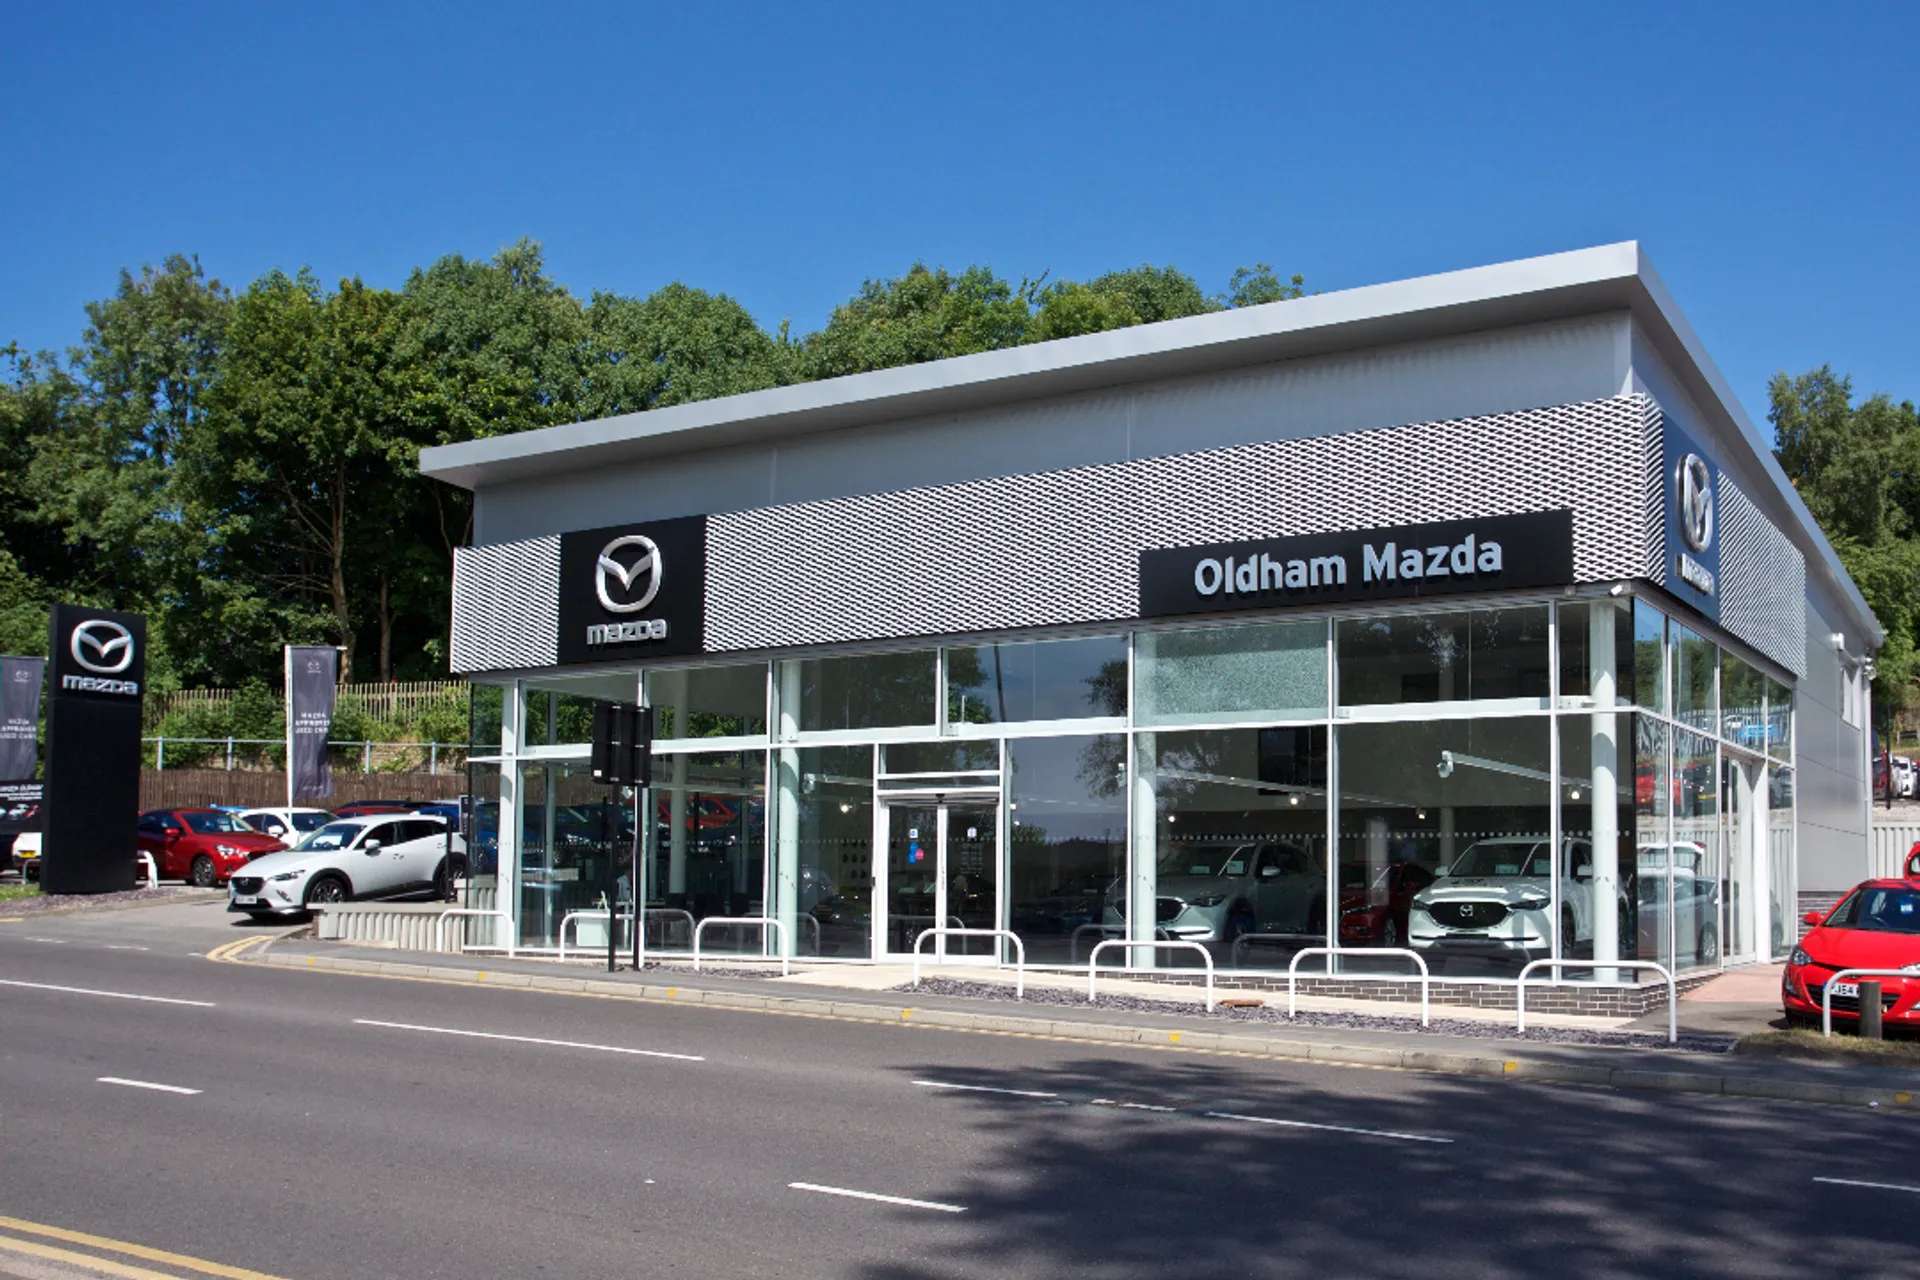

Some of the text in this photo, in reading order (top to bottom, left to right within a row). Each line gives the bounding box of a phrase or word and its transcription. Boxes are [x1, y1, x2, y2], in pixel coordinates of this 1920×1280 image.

[1194, 533, 1503, 595] Oldham Mazda
[1681, 552, 1715, 597] mazda
[586, 618, 668, 645] mazda
[63, 674, 138, 695] mazda
